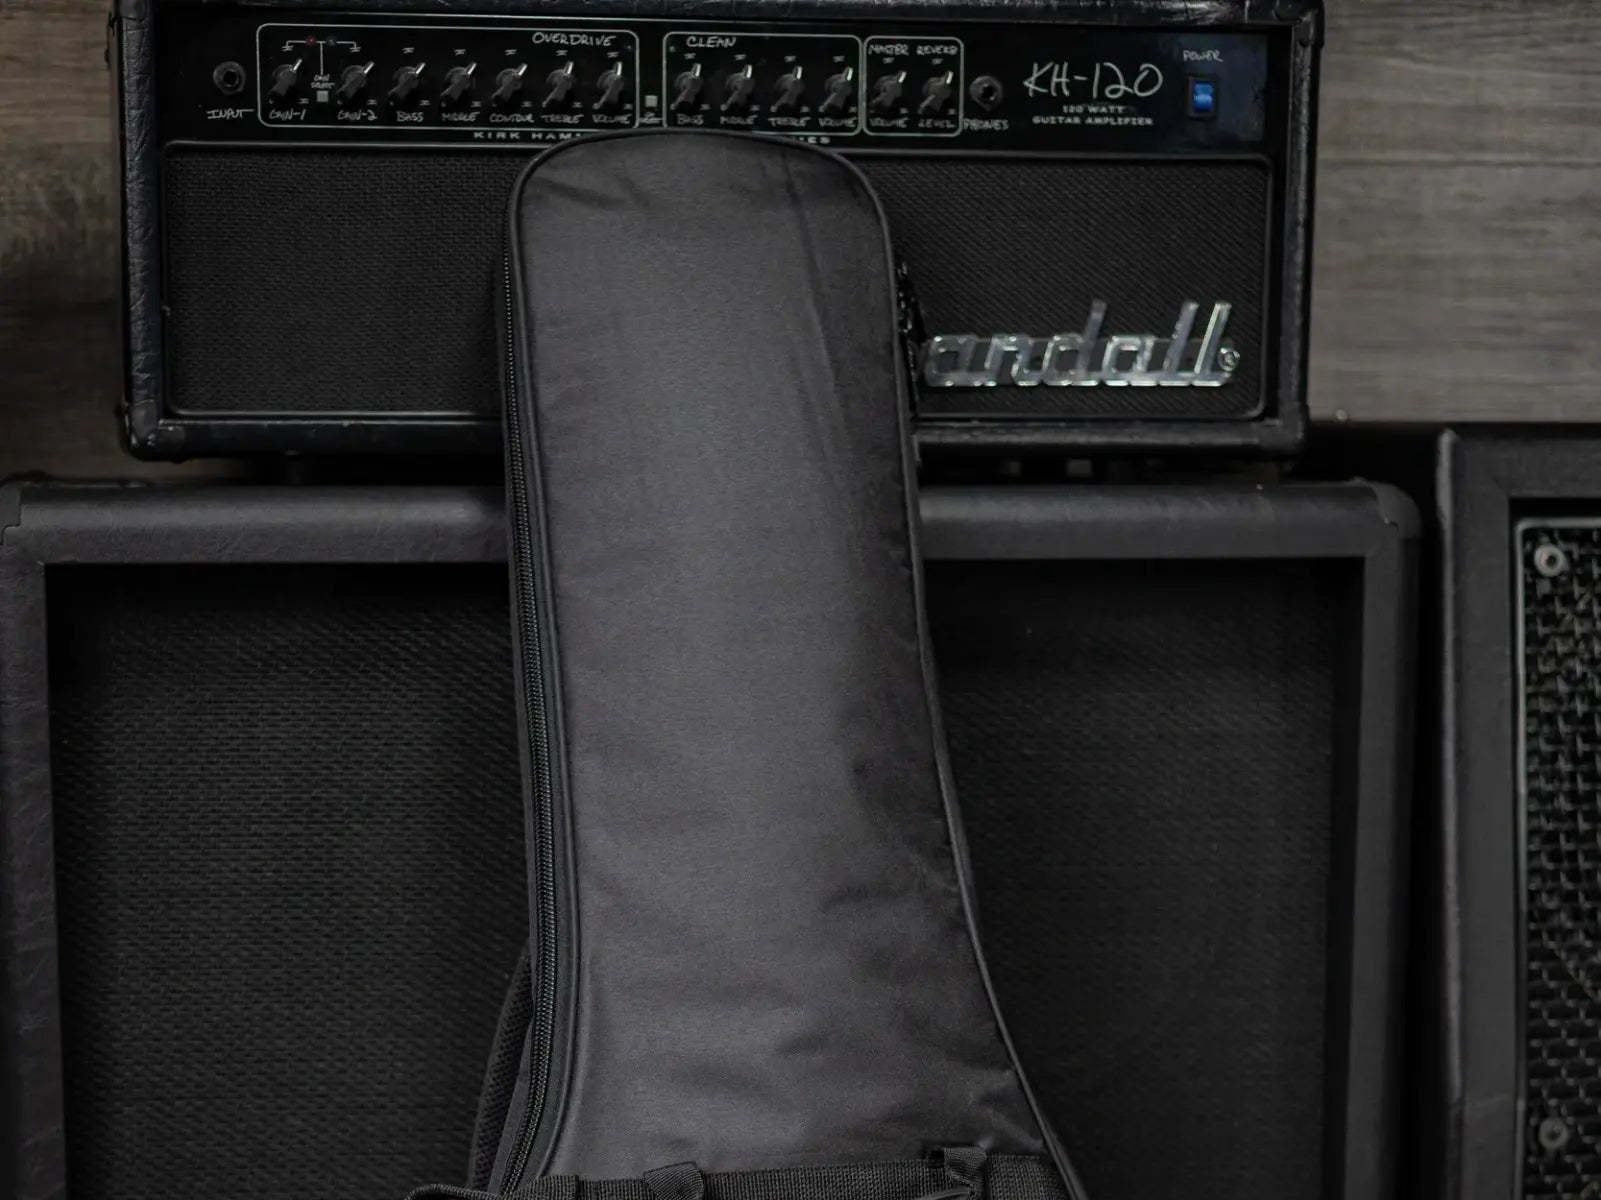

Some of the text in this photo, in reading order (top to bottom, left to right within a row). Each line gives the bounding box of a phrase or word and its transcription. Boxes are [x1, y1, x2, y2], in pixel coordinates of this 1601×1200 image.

[532, 31, 616, 47] OVERDRIVE
[685, 36, 737, 48] CLEAN
[868, 44, 909, 55] MASTER
[1183, 50, 1224, 62] POWER
[1022, 61, 1164, 100] KH-120
[206, 109, 255, 120] INPUT
[268, 108, 306, 121] GAIN-1
[337, 109, 379, 122] GAIN-2
[396, 111, 424, 122] BASS
[676, 113, 704, 125] BASS
[1032, 116, 1081, 125] GUITAR
[473, 131, 521, 140] KIRK
[925, 299, 1232, 387] andall
